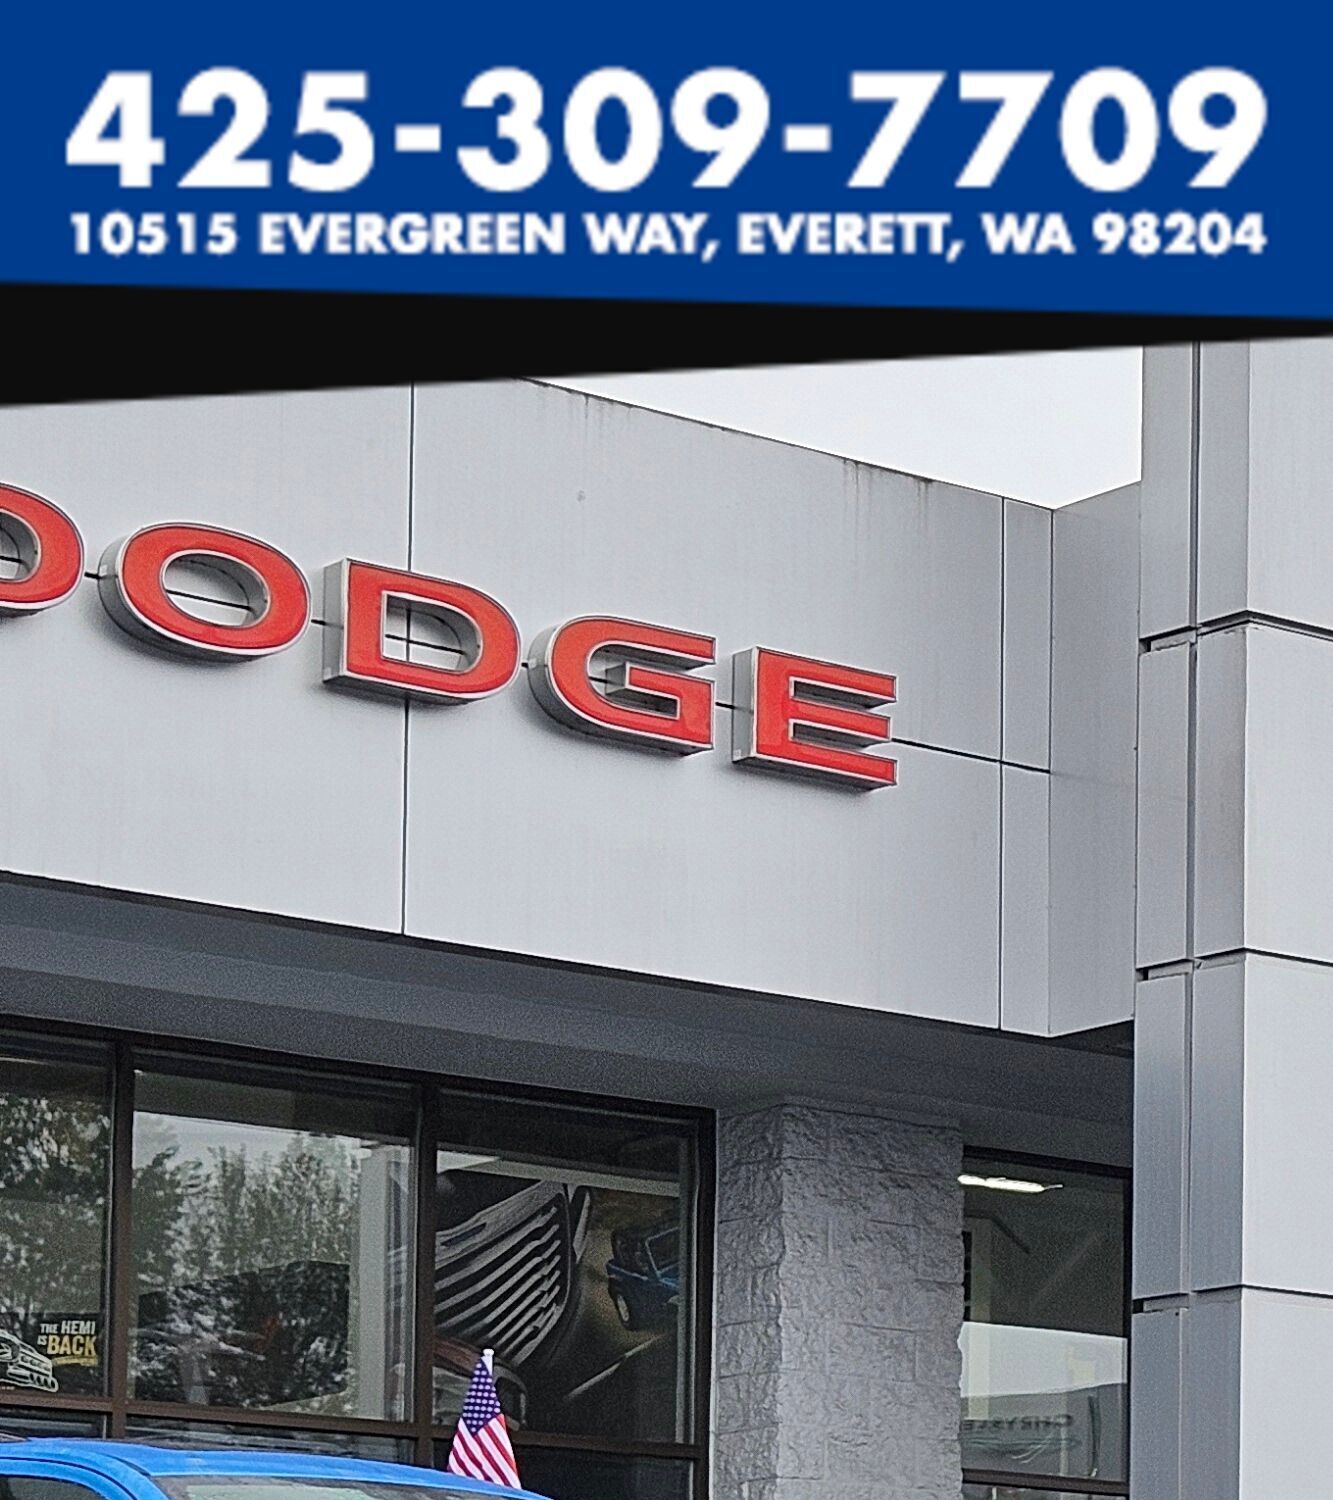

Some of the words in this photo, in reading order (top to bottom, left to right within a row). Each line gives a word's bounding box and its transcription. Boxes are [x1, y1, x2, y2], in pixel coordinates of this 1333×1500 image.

[40, 1323, 59, 1334] THE
[61, 1320, 96, 1335] HEMI
[37, 1335, 48, 1346] IS
[47, 1334, 97, 1356] BACK
